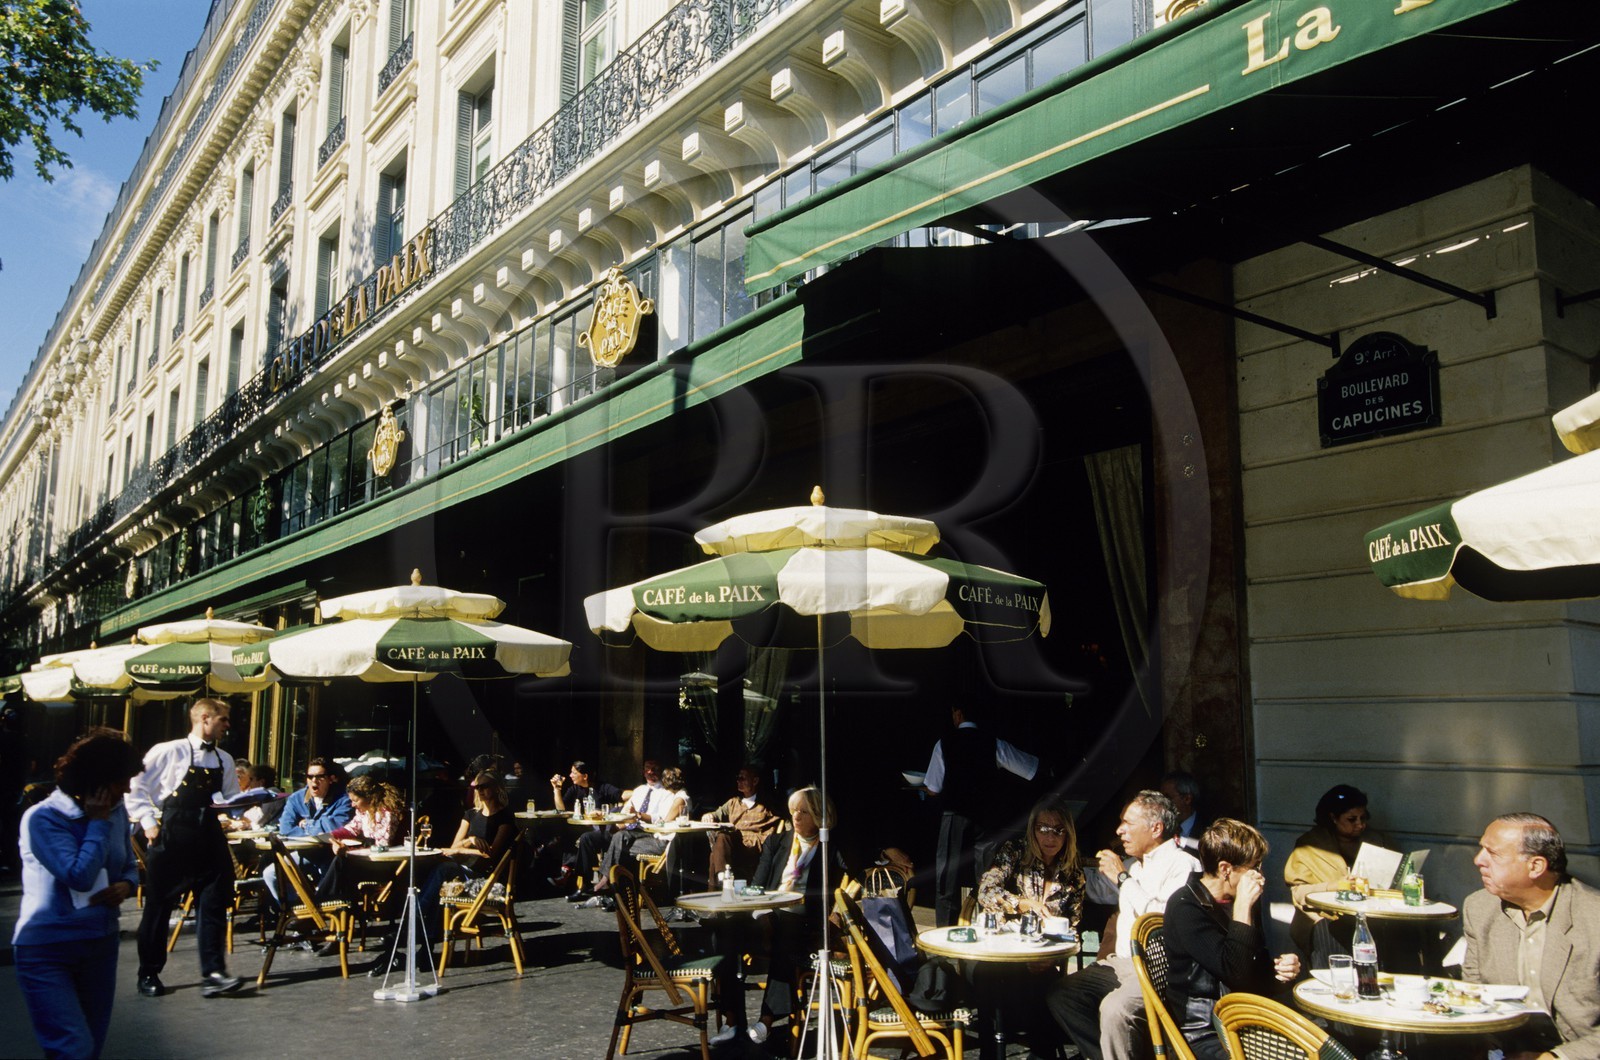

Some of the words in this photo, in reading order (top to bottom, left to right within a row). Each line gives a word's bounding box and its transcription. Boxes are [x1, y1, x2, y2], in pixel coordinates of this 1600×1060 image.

[1241, 7, 1342, 76] La
[343, 285, 367, 337] LA
[375, 227, 432, 312] PAIX
[600, 323, 629, 358] PAIX
[1341, 372, 1409, 398] BOULEVARD
[1365, 395, 1384, 406] DES
[1332, 400, 1423, 430] CAPUCINES
[1369, 533, 1392, 563] CAFÉ
[1392, 540, 1401, 556] de
[1401, 538, 1410, 555] la
[1409, 523, 1452, 552] PAIX
[642, 585, 686, 606] CAFÉ
[689, 592, 702, 604] de
[705, 591, 716, 603] la
[718, 584, 765, 602] PAIX
[958, 585, 993, 604] CAFÉ
[995, 595, 1004, 605] de
[1005, 596, 1013, 607] la
[1014, 593, 1039, 612] PAIX
[387, 646, 425, 660] CAFÉ
[428, 650, 439, 659] de
[441, 650, 450, 659] la
[452, 646, 486, 659] PAIX
[131, 663, 159, 674] CAFÉ
[177, 665, 204, 675] PAIX
